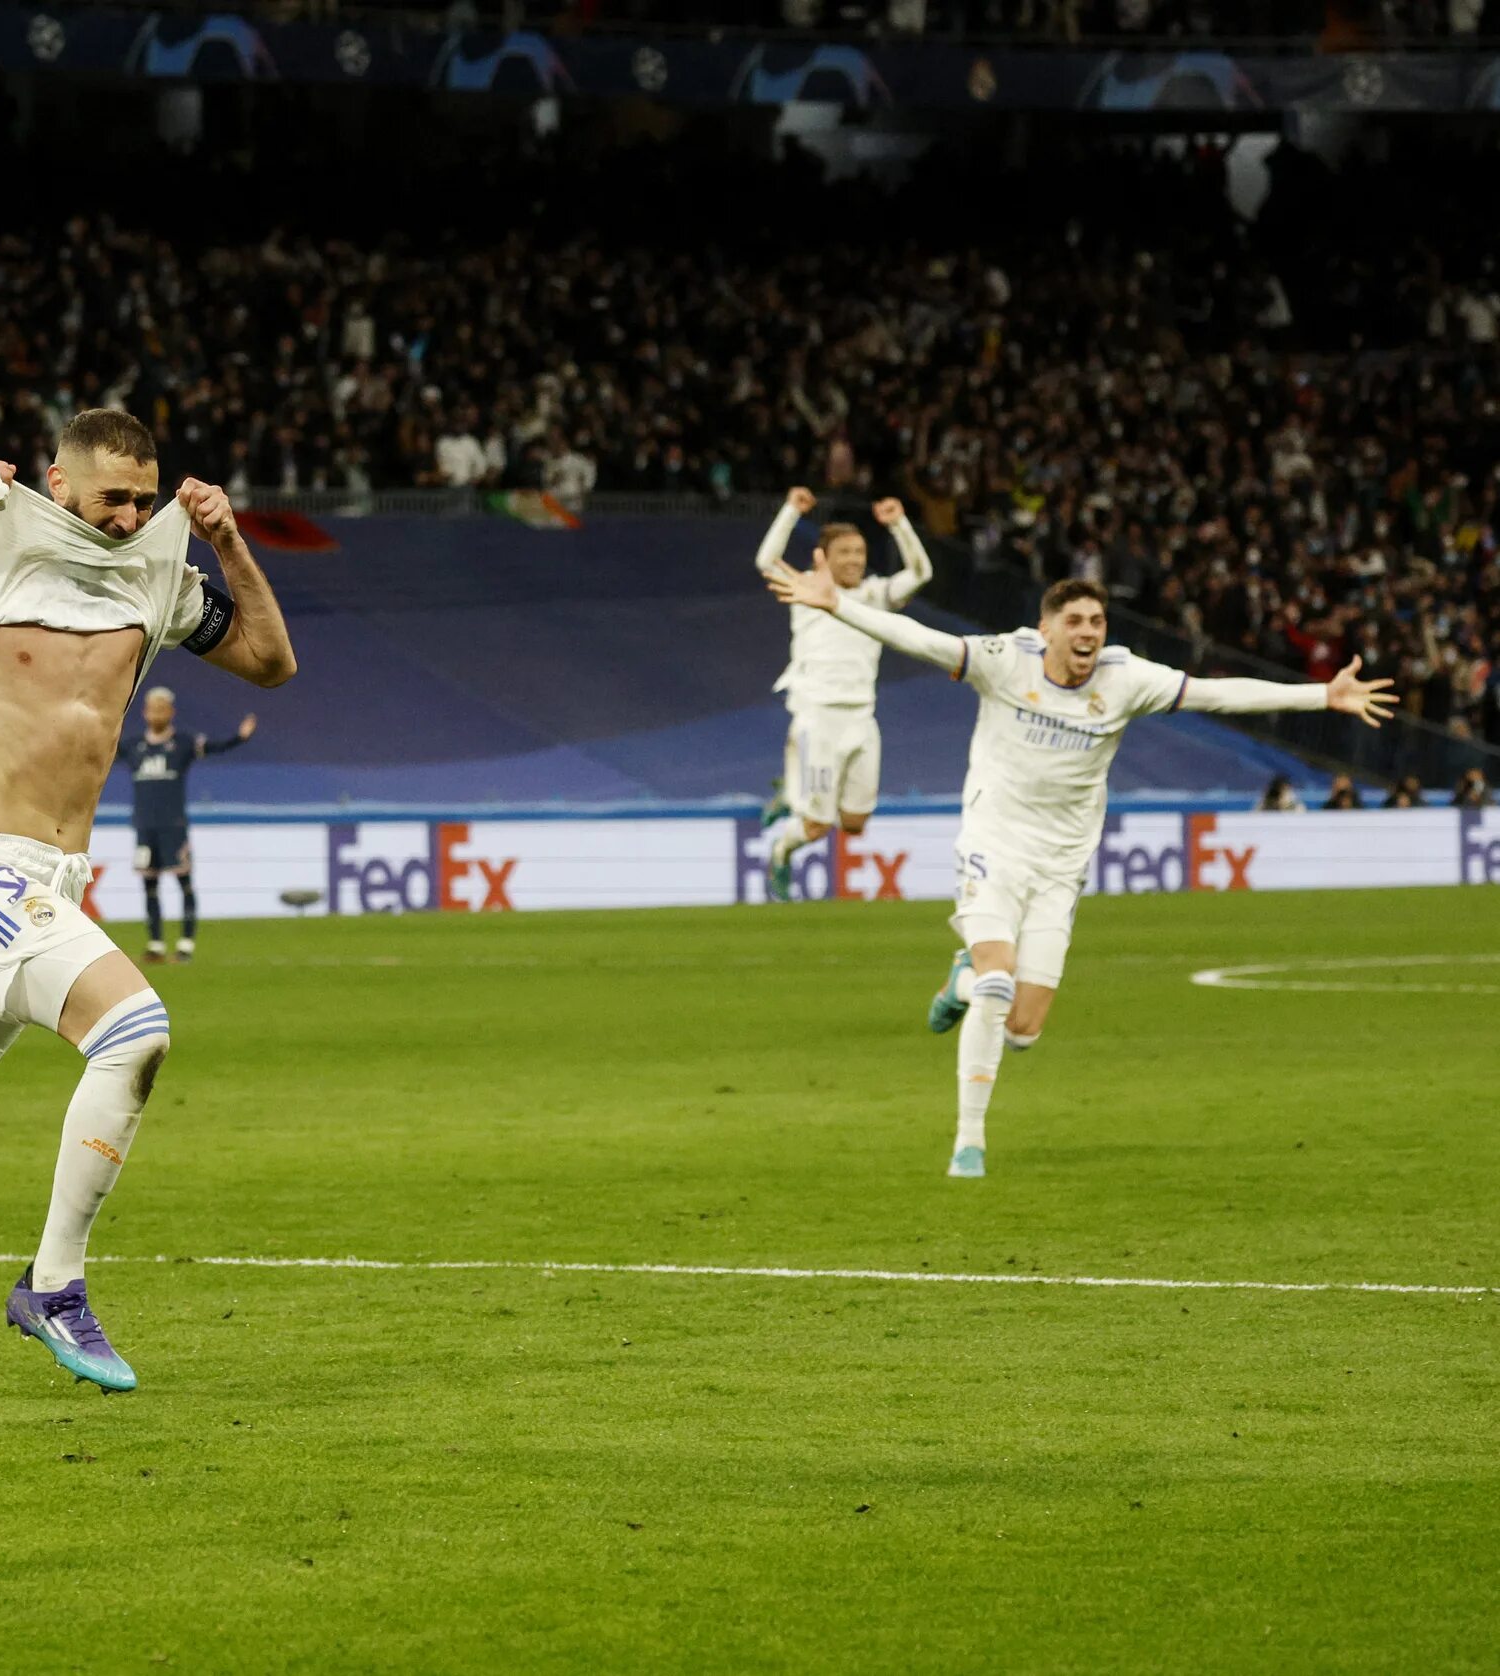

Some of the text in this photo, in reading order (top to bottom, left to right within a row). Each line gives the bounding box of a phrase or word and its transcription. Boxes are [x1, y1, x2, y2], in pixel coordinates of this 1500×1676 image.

[329, 822, 517, 912] FedEx
[737, 818, 907, 900] FdEx
[1097, 813, 1256, 893] FedEx
